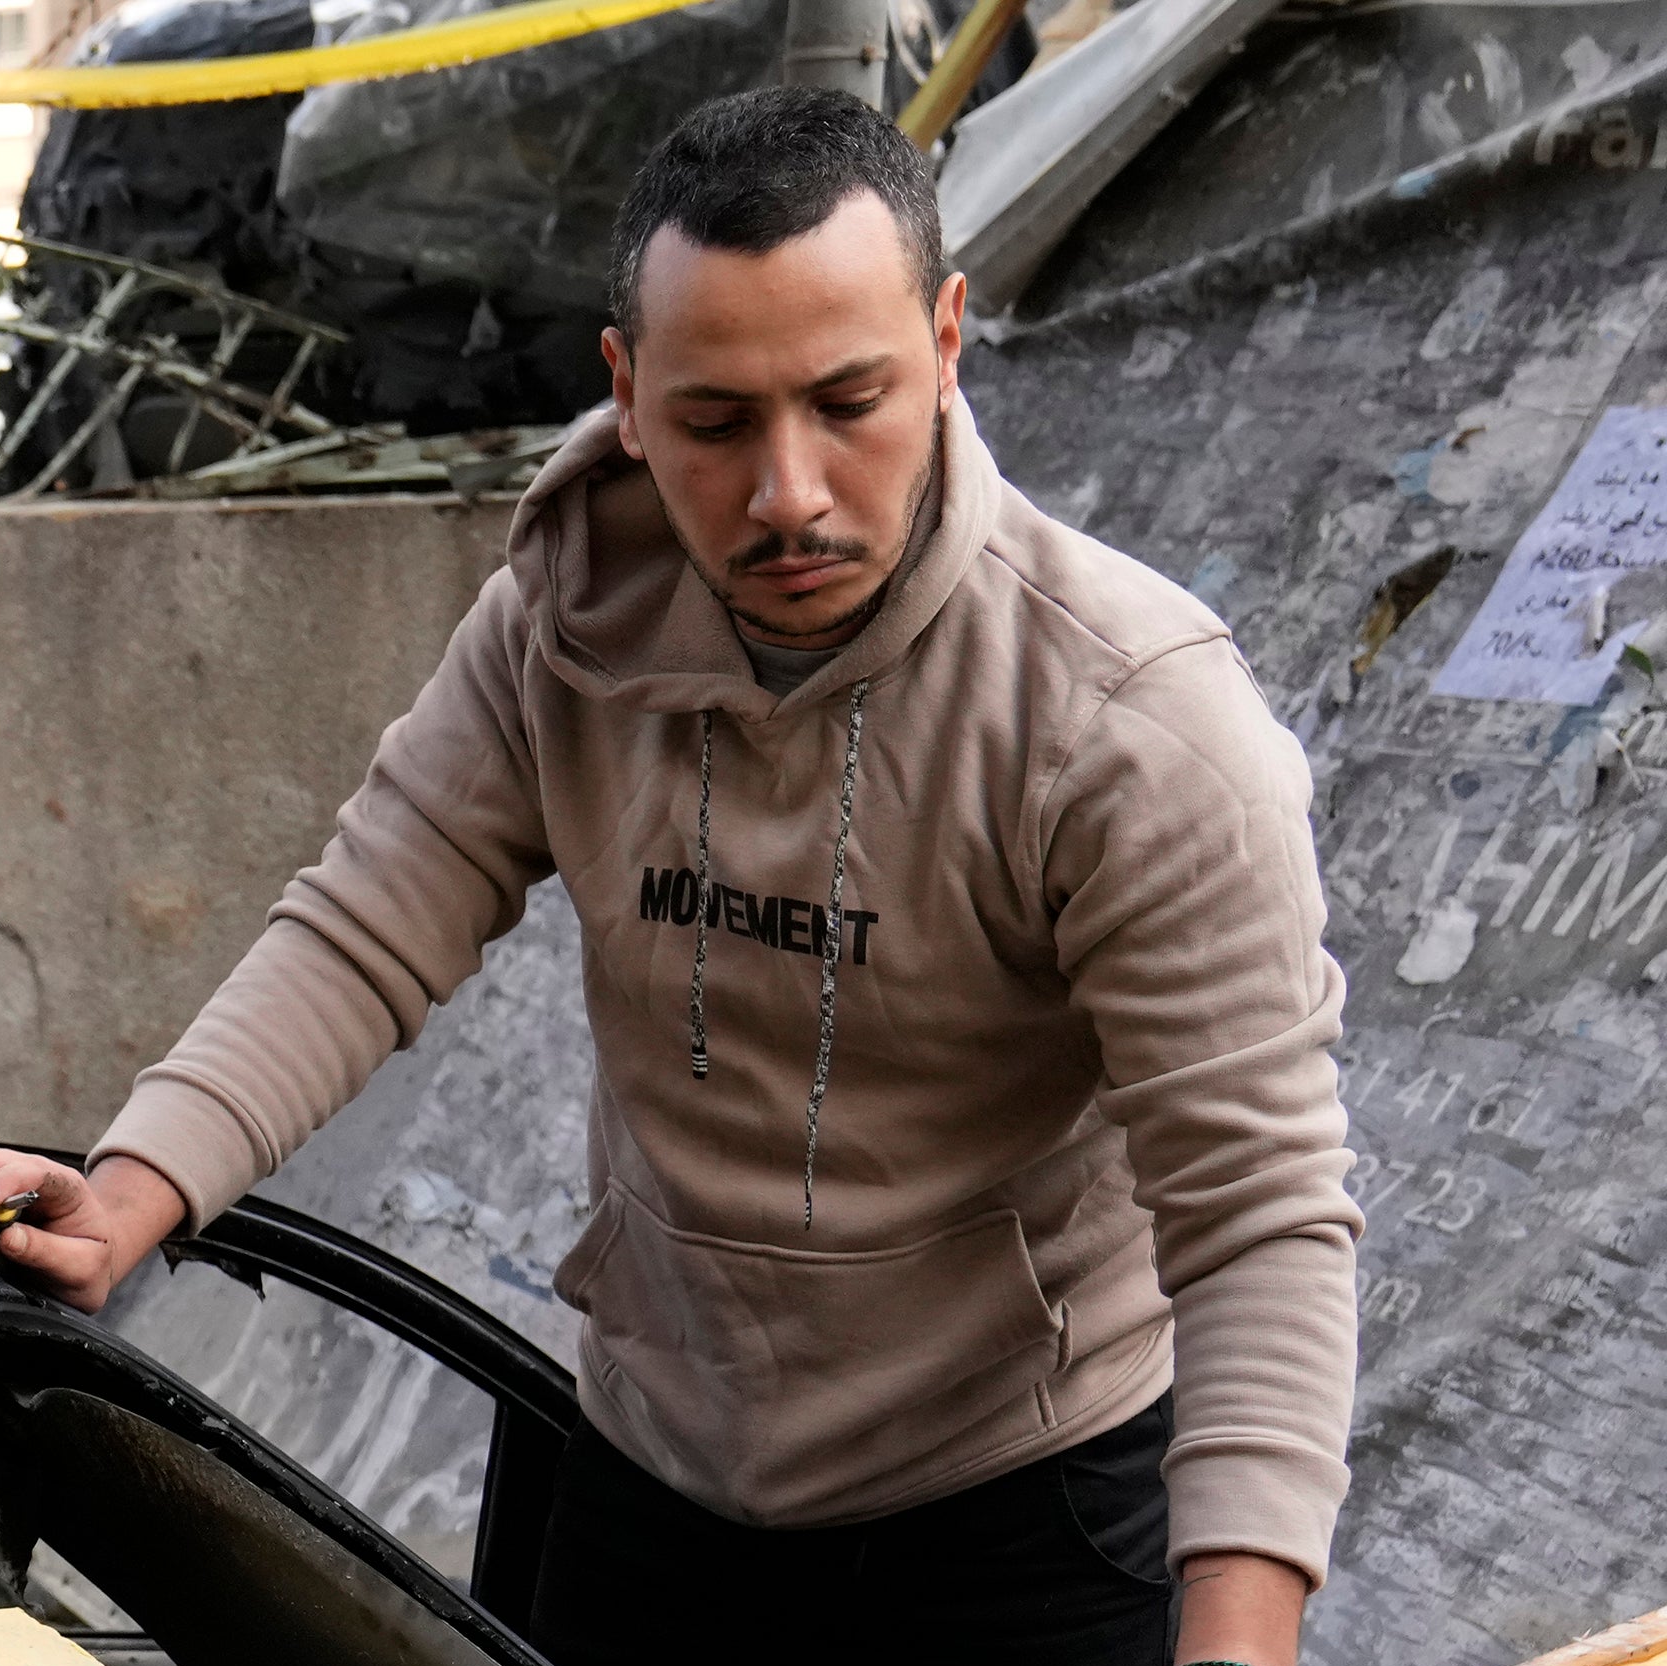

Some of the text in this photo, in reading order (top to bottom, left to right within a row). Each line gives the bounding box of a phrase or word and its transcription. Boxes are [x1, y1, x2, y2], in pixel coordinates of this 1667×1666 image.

[639, 866, 879, 965] MOVEMENT
[1393, 1065, 1466, 1125] 41
[1403, 1168, 1487, 1234] 23
